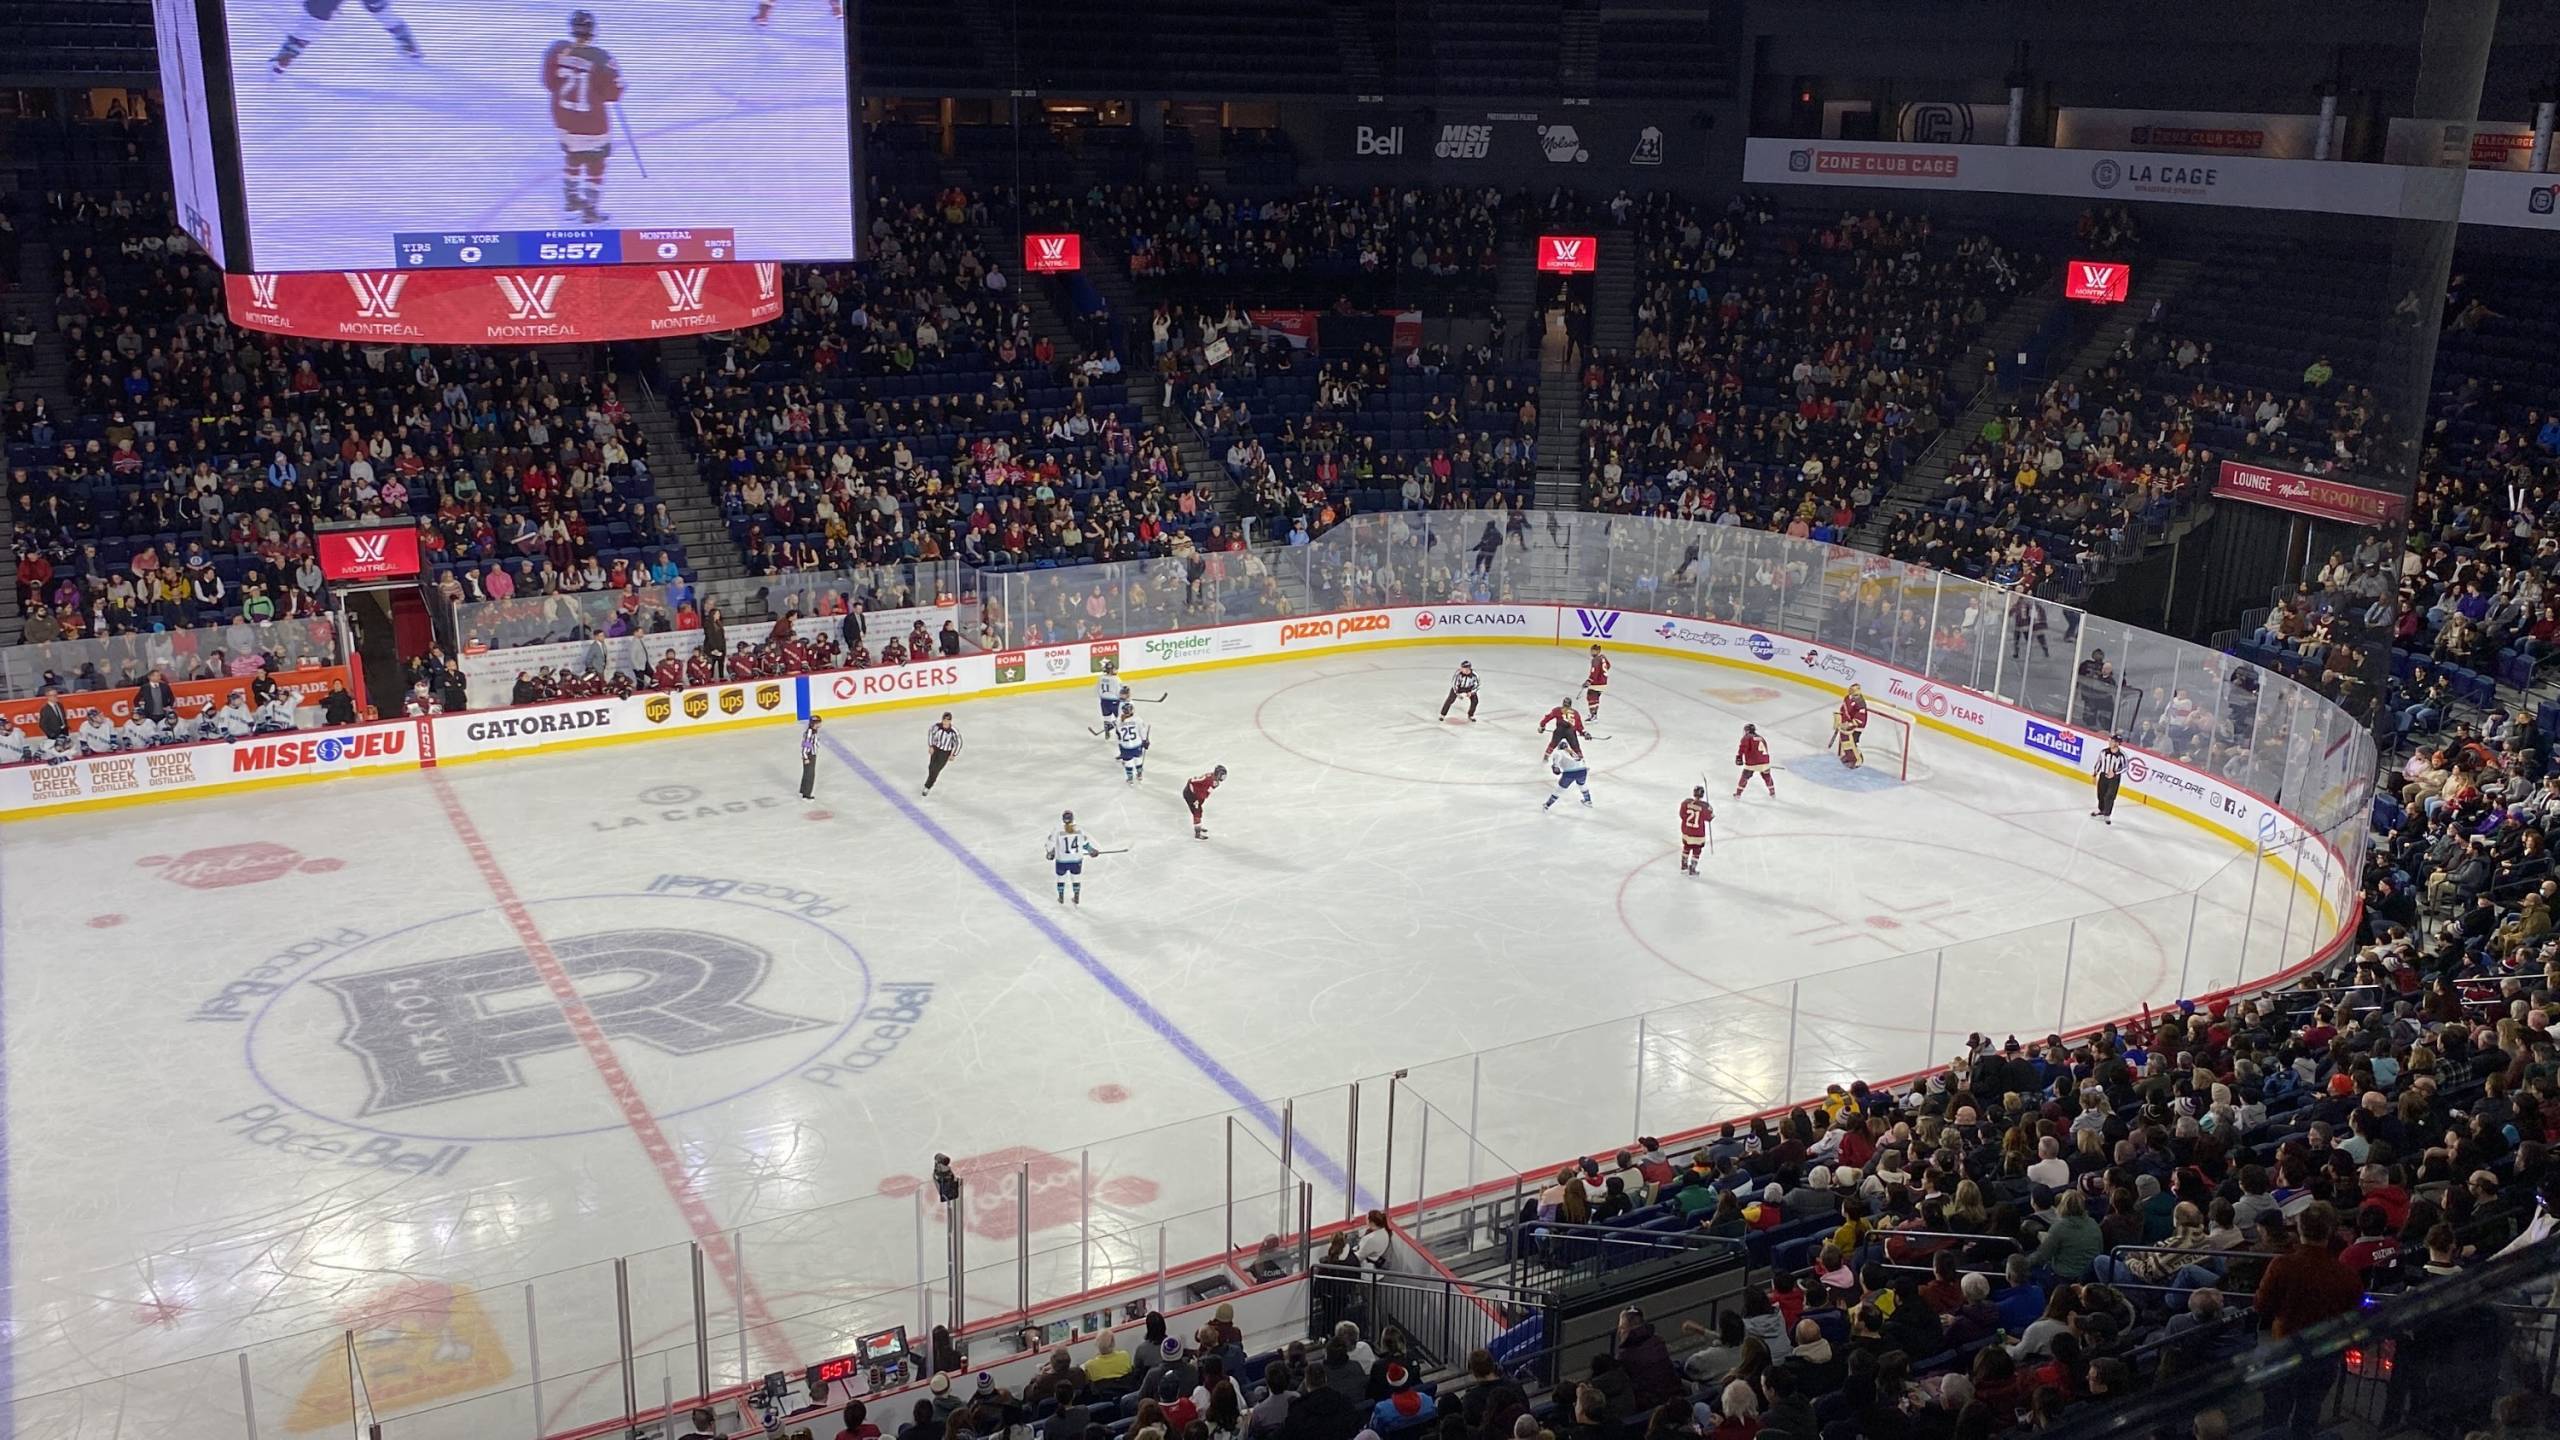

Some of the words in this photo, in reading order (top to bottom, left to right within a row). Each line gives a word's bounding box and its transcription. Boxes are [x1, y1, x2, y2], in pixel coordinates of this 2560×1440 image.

[557, 67, 591, 112] 21
[1356, 125, 1404, 156] Bell
[1442, 125, 1493, 142] MISE
[1540, 135, 1579, 154] Molson
[1819, 156, 1860, 170] ZONE
[1866, 157, 1907, 171] CLUB
[1912, 158, 1955, 174] CAGE
[2128, 165, 2151, 182] LA
[2161, 167, 2217, 185] CAGE
[443, 235, 466, 244] NEW
[471, 235, 500, 243] YORK
[546, 231, 586, 239] PÉRIODE
[640, 231, 691, 240] MONTRÉAL
[403, 243, 431, 252] TIRS
[459, 246, 482, 263] 0
[540, 243, 603, 260] 5:57
[657, 243, 678, 258] 0
[711, 247, 724, 258] 8
[409, 253, 424, 264] 8
[245, 311, 294, 328] MONTRÉAL
[651, 314, 720, 330] MONTRÉAL
[340, 322, 424, 336] MONTRÉAL
[487, 323, 580, 337] MONTRÉAL
[2233, 470, 2272, 492] LOUNGE
[2278, 484, 2309, 498] Molson
[2310, 486, 2369, 511] EXPORT
[341, 562, 400, 575] MONTRÉAL
[1439, 613, 1462, 625] AIR
[1464, 612, 1526, 625] CANADA
[1092, 644, 1117, 655] ROMA
[1145, 635, 1212, 653] Schneider
[997, 655, 1024, 665] ROMA
[1044, 649, 1071, 658] ROMA
[1174, 648, 1211, 658] Electric
[863, 665, 959, 694] ROGERS
[684, 697, 708, 716] ups
[720, 693, 744, 712] ups
[757, 689, 780, 708] ups
[1888, 678, 1913, 701] Tims
[1915, 682, 1948, 718] 60
[1950, 704, 1984, 726] YEARS
[14, 706, 96, 725] GATADE
[646, 701, 671, 720] ups
[467, 707, 612, 742] GATORADE
[419, 721, 433, 758] CCM
[1121, 726, 1137, 742] 25
[2028, 726, 2080, 757] Lafleur
[344, 729, 406, 760] JEU
[146, 751, 193, 767] WOODY
[233, 740, 317, 773] MISE
[29, 765, 78, 781] WOODY
[89, 757, 136, 774] WOODY
[150, 764, 193, 779] CREEK
[33, 778, 78, 793] CREEK
[92, 770, 136, 786] CREEK
[149, 774, 196, 787] DISTILLERS
[2151, 769, 2206, 796] TRICOLORE
[32, 788, 81, 800] DISTILLERS
[91, 781, 139, 793] DISTILLERS
[591, 816, 648, 832] LA
[660, 796, 780, 822] CAGE
[1686, 810, 1700, 828] 21
[1063, 835, 1079, 854] 14
[822, 1360, 854, 1381] 5:57
